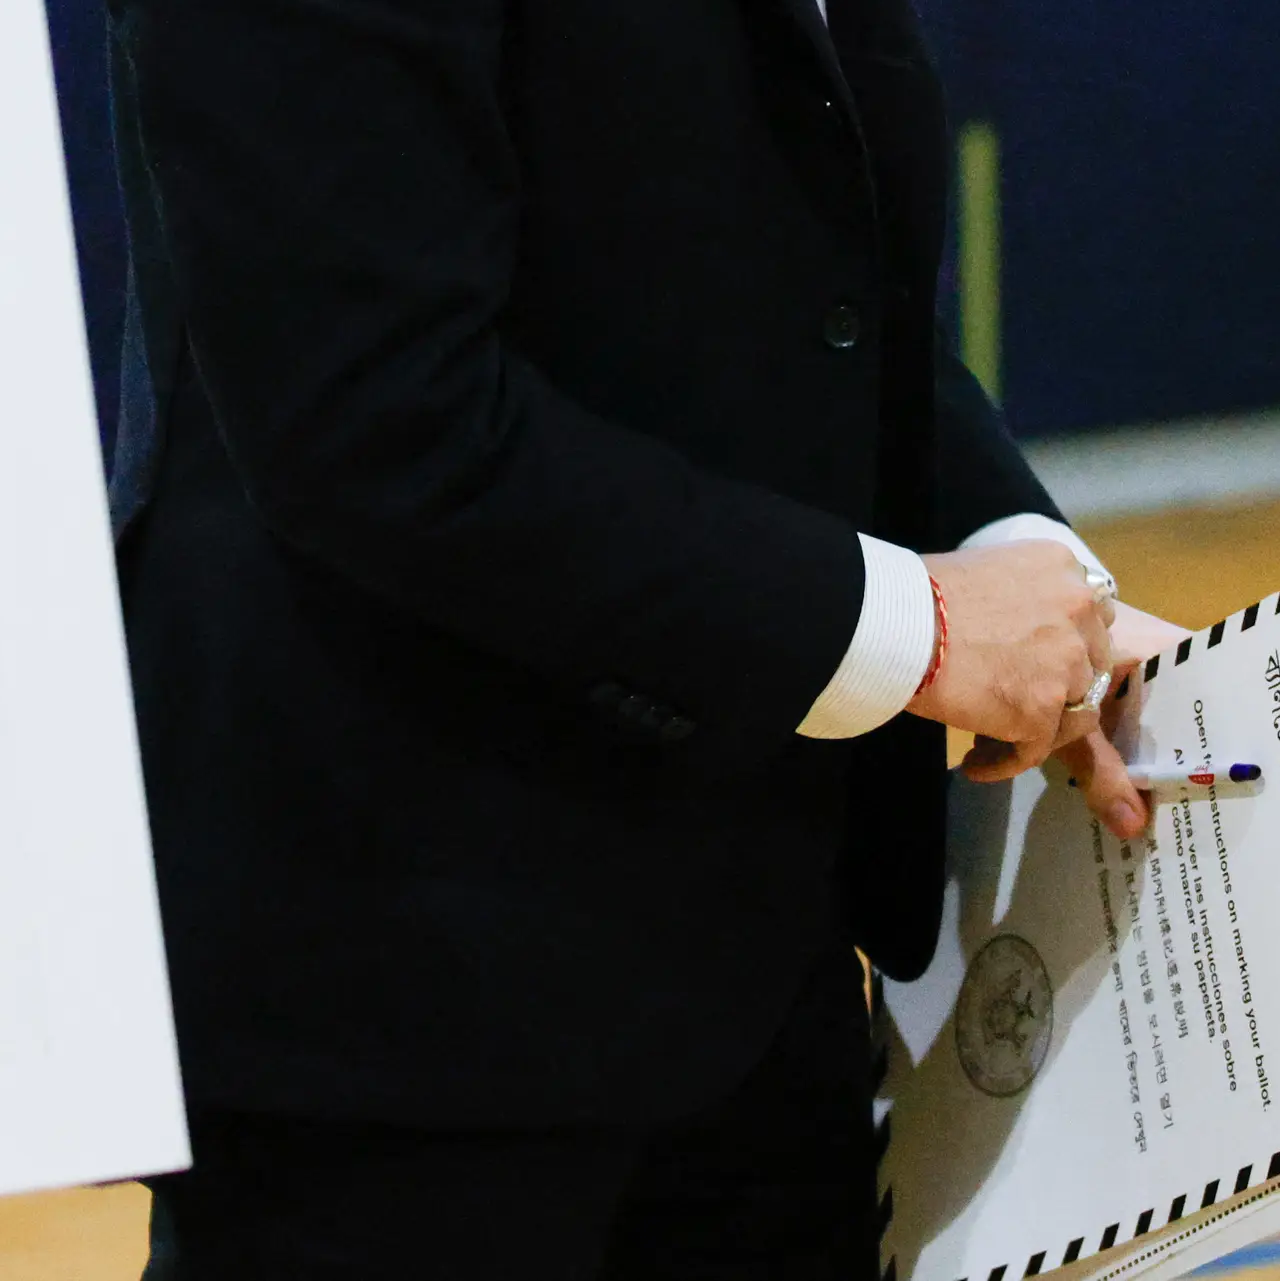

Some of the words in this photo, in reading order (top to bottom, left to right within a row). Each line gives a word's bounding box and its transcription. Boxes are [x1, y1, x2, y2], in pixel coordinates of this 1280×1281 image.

[1193, 699, 1208, 749] Open
[1172, 806, 1184, 857] cómo
[1179, 796, 1194, 839] para
[1207, 783, 1232, 894] instructions
[1188, 842, 1199, 871] ver
[1179, 862, 1196, 925] marcar
[1193, 876, 1204, 905] las
[1227, 899, 1238, 924] on
[1190, 931, 1201, 955] su
[1232, 928, 1253, 1005] marking
[1198, 909, 1228, 1034] instrucciones
[1193, 959, 1216, 1044] papeleta.
[1244, 1007, 1261, 1049] your
[1222, 1040, 1237, 1092] sobre
[1254, 1054, 1272, 1113] ballot.
